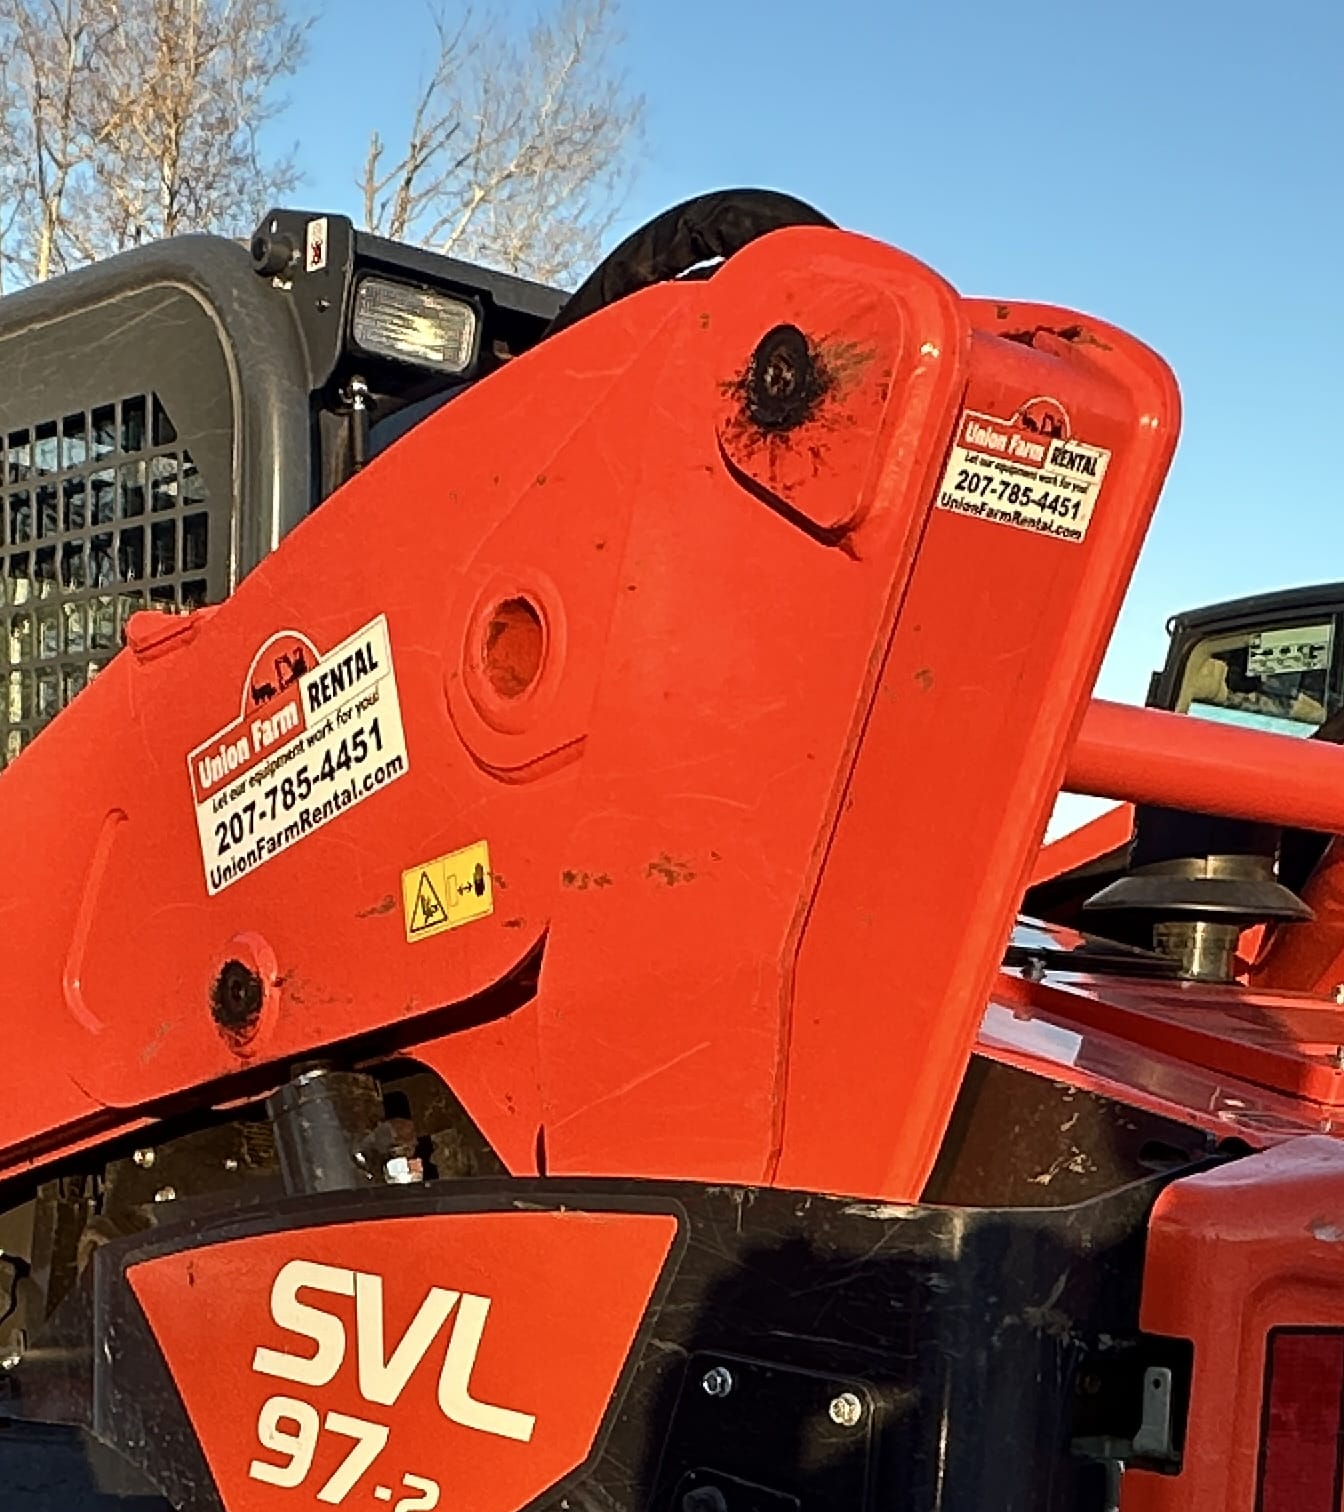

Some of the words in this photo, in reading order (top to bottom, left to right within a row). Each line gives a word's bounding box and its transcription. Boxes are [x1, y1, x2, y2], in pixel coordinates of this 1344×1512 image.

[955, 469, 1082, 521] 207-785-4451
[965, 421, 1007, 452] Union
[1008, 434, 1045, 462] Farm
[1051, 446, 1099, 477] RENTAL
[941, 492, 1082, 540] UnionFarmRental.com
[197, 735, 250, 789] Union
[251, 701, 300, 753] Farm
[306, 642, 379, 713] RENTAL
[212, 790, 229, 814] Let
[248, 739, 304, 788] equipment
[306, 719, 334, 748] work
[336, 706, 353, 729] for
[210, 753, 405, 890] UnionFarmRental.com
[214, 717, 384, 857] 207-785-4451
[252, 1259, 537, 1443] SVL
